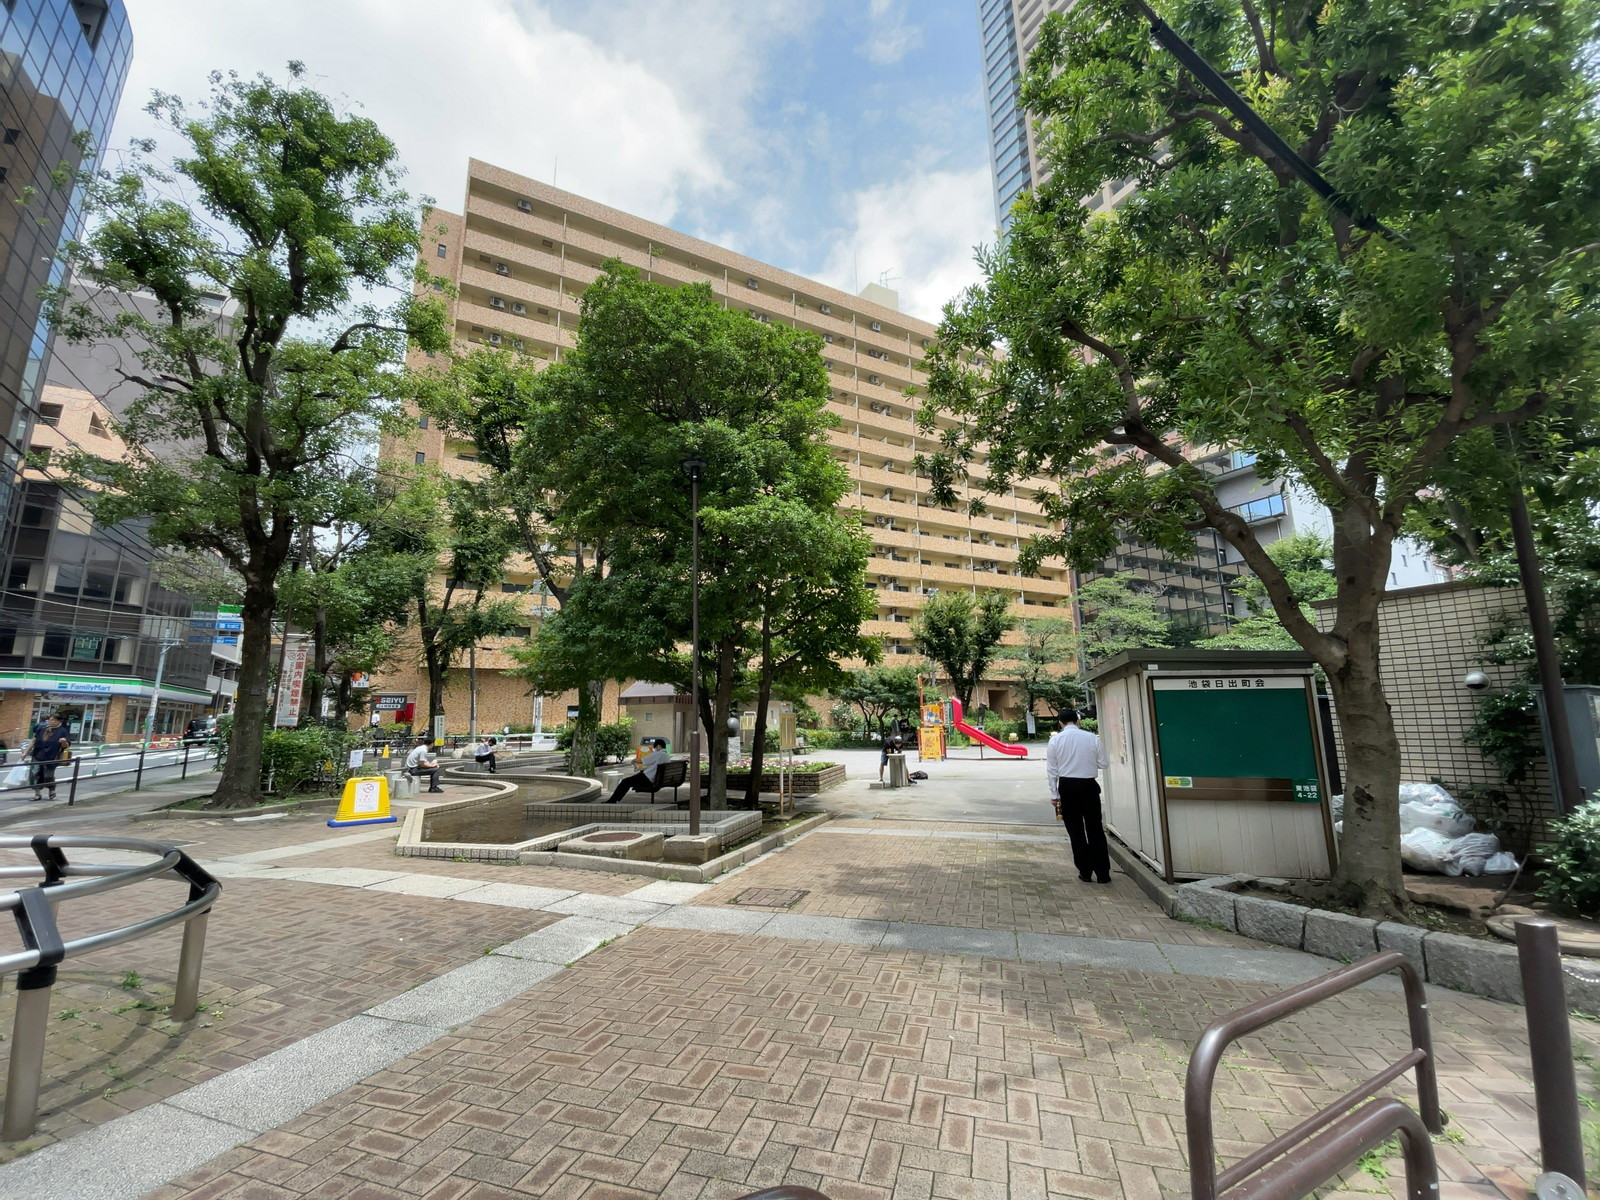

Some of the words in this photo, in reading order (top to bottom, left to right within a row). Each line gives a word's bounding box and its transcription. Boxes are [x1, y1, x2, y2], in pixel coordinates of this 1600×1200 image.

[70, 683, 111, 691] FamilyMart
[287, 652, 306, 716] 公園内喫煙禁止
[1188, 679, 1265, 688] 池袋日出町会
[1295, 784, 1318, 792] 東池袋
